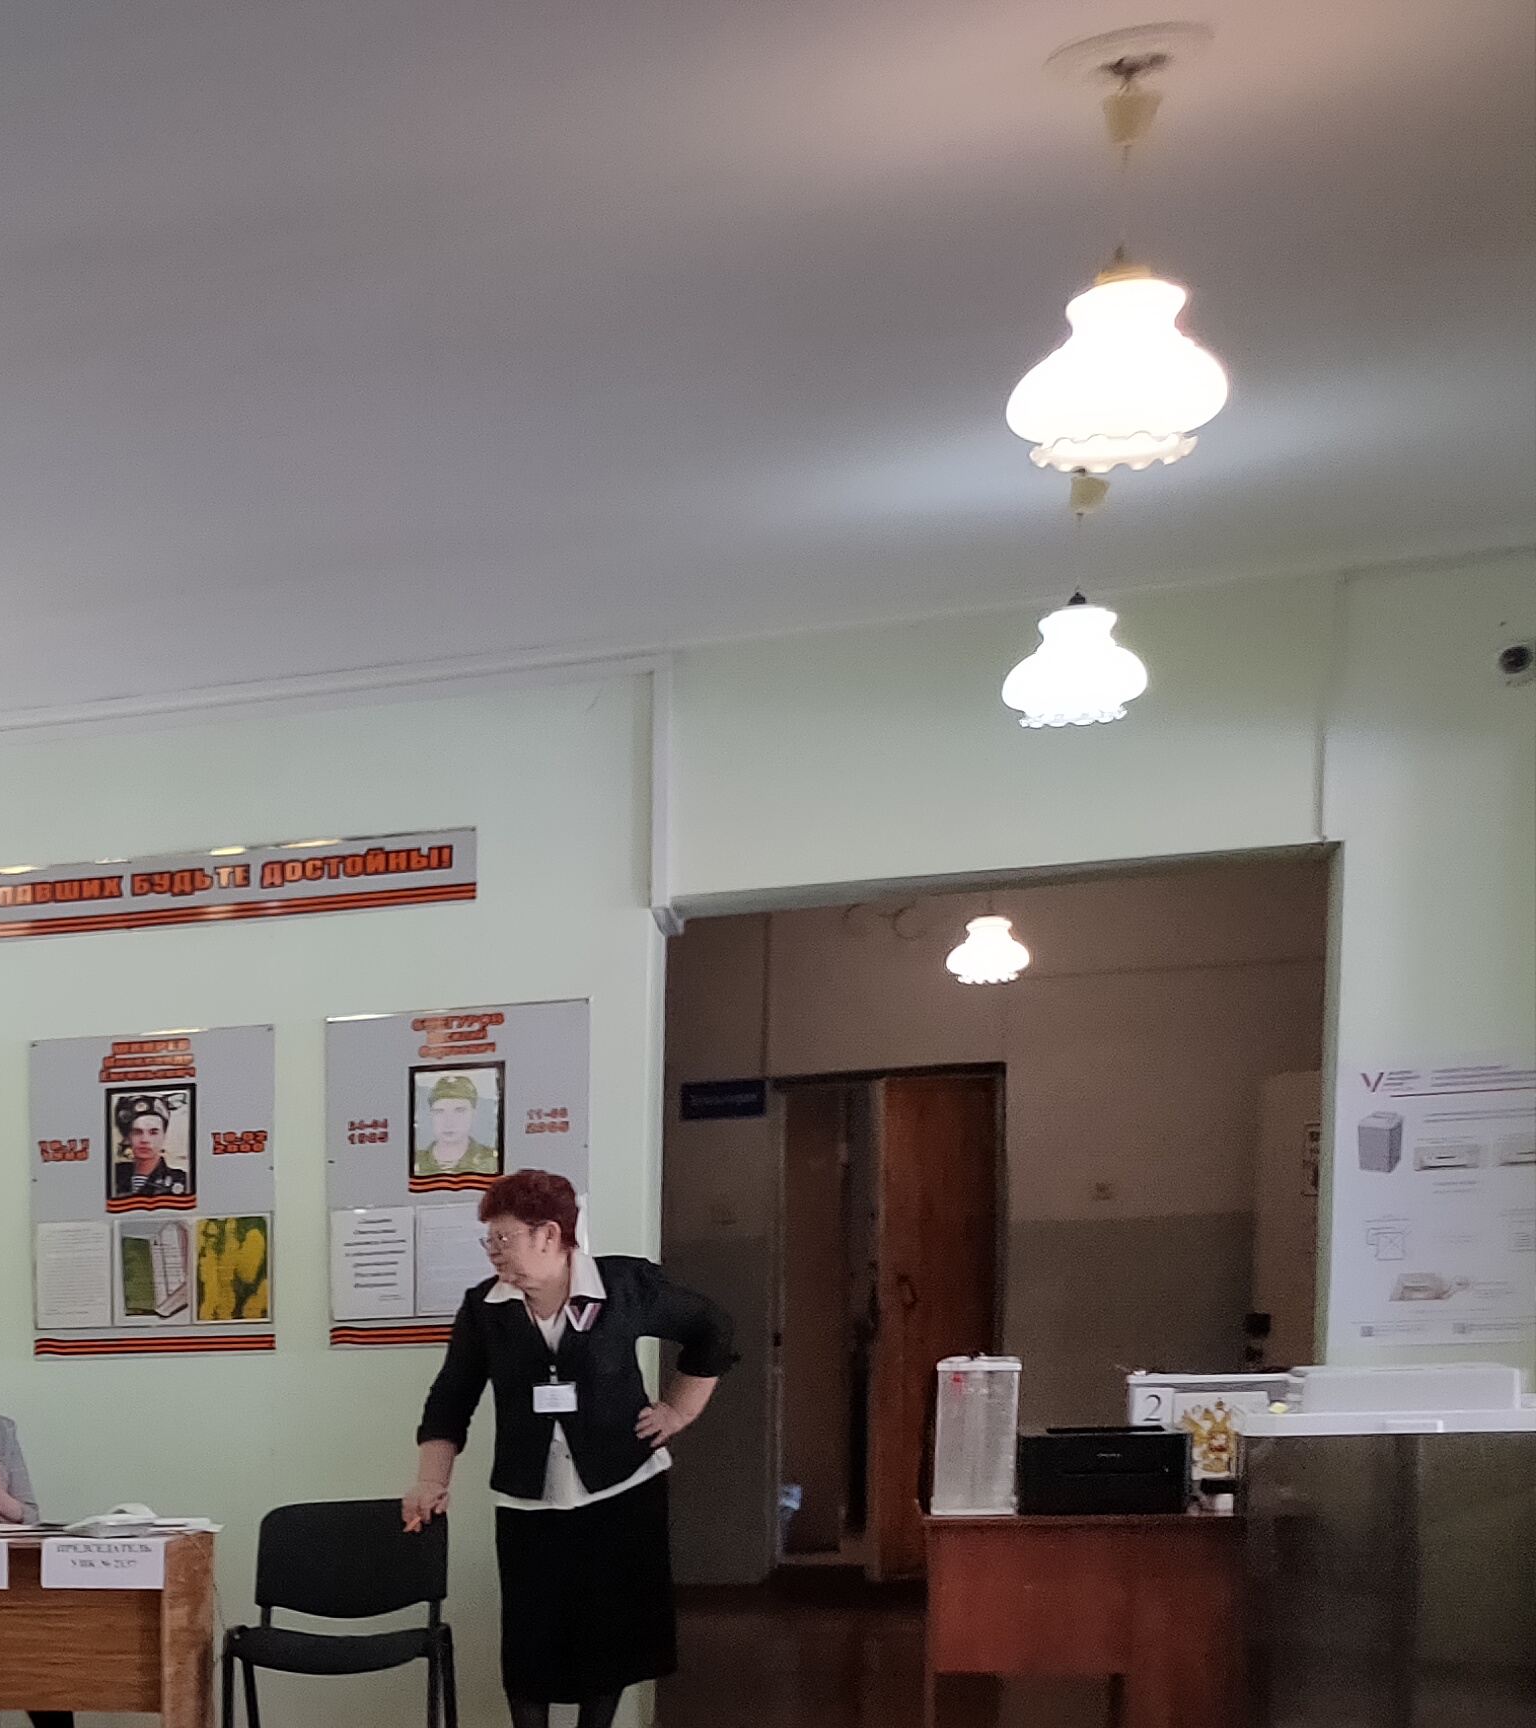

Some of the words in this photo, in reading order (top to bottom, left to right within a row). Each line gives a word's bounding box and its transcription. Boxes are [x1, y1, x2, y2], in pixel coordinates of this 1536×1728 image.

[131, 863, 251, 897] БУДЬТЕ
[260, 845, 453, 889] ДОСТОЙНЫ!
[1143, 1394, 1162, 1422] 2
